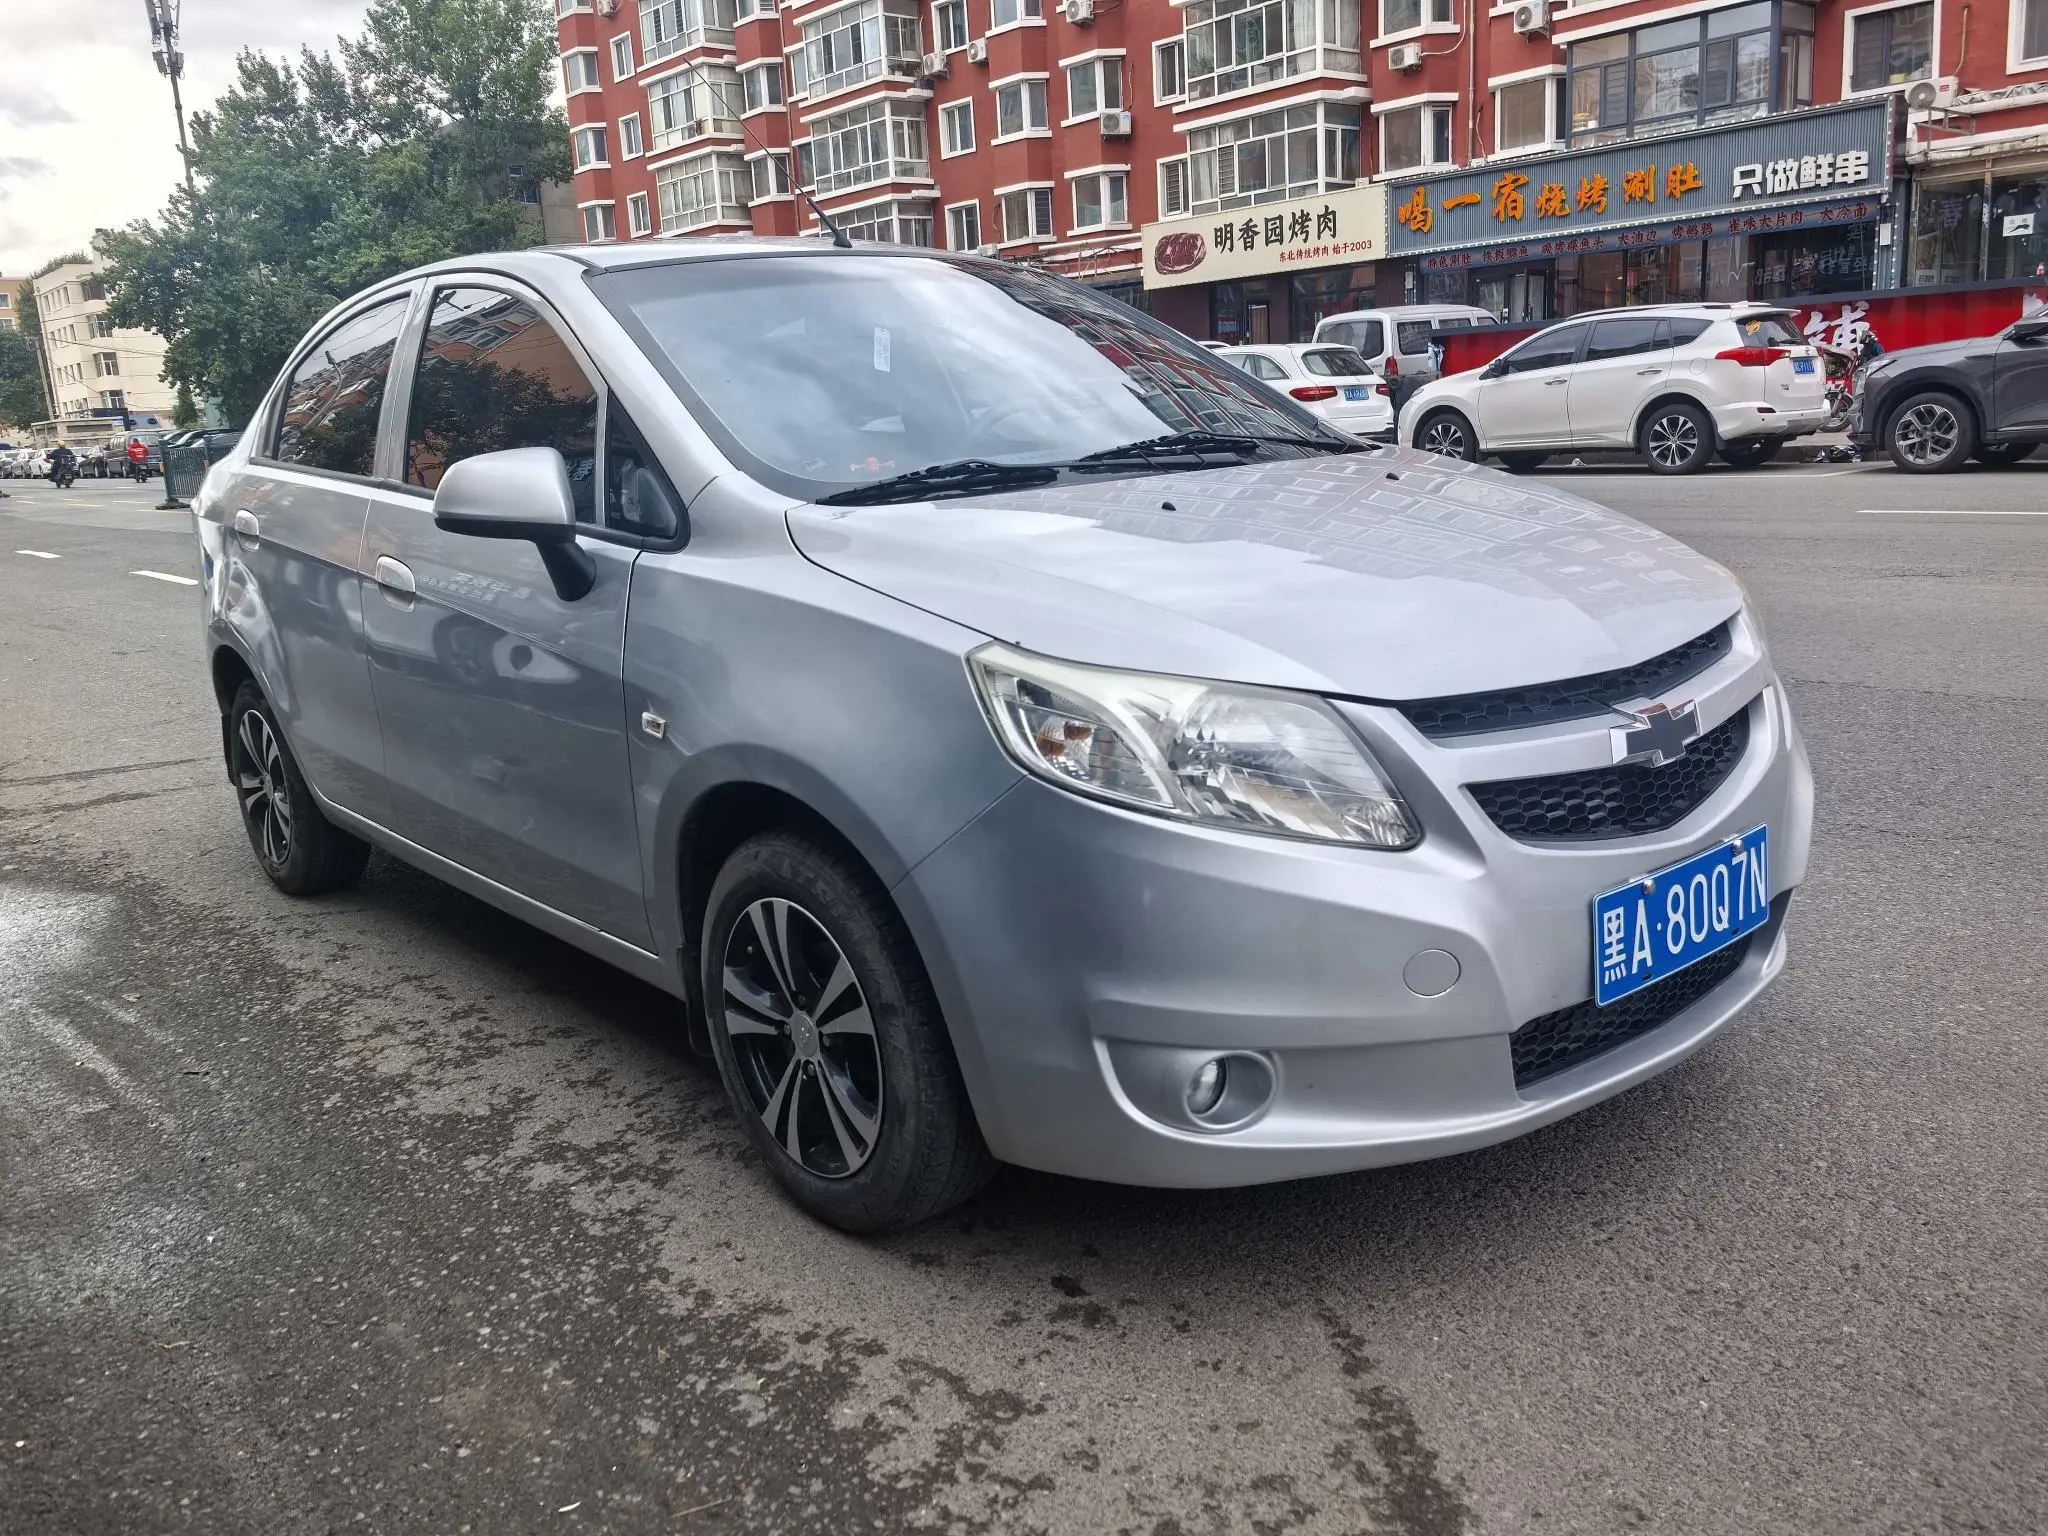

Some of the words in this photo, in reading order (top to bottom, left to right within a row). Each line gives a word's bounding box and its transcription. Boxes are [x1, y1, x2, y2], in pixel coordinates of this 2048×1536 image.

[1398, 162, 1702, 233] 喝一宿烧烤涮肚
[1732, 150, 1869, 198] 只做鲜串
[1213, 205, 1337, 254] 明香园烤肉
[1279, 245, 1329, 262] 东北传统烤肉
[1332, 240, 1372, 255] 始于2003
